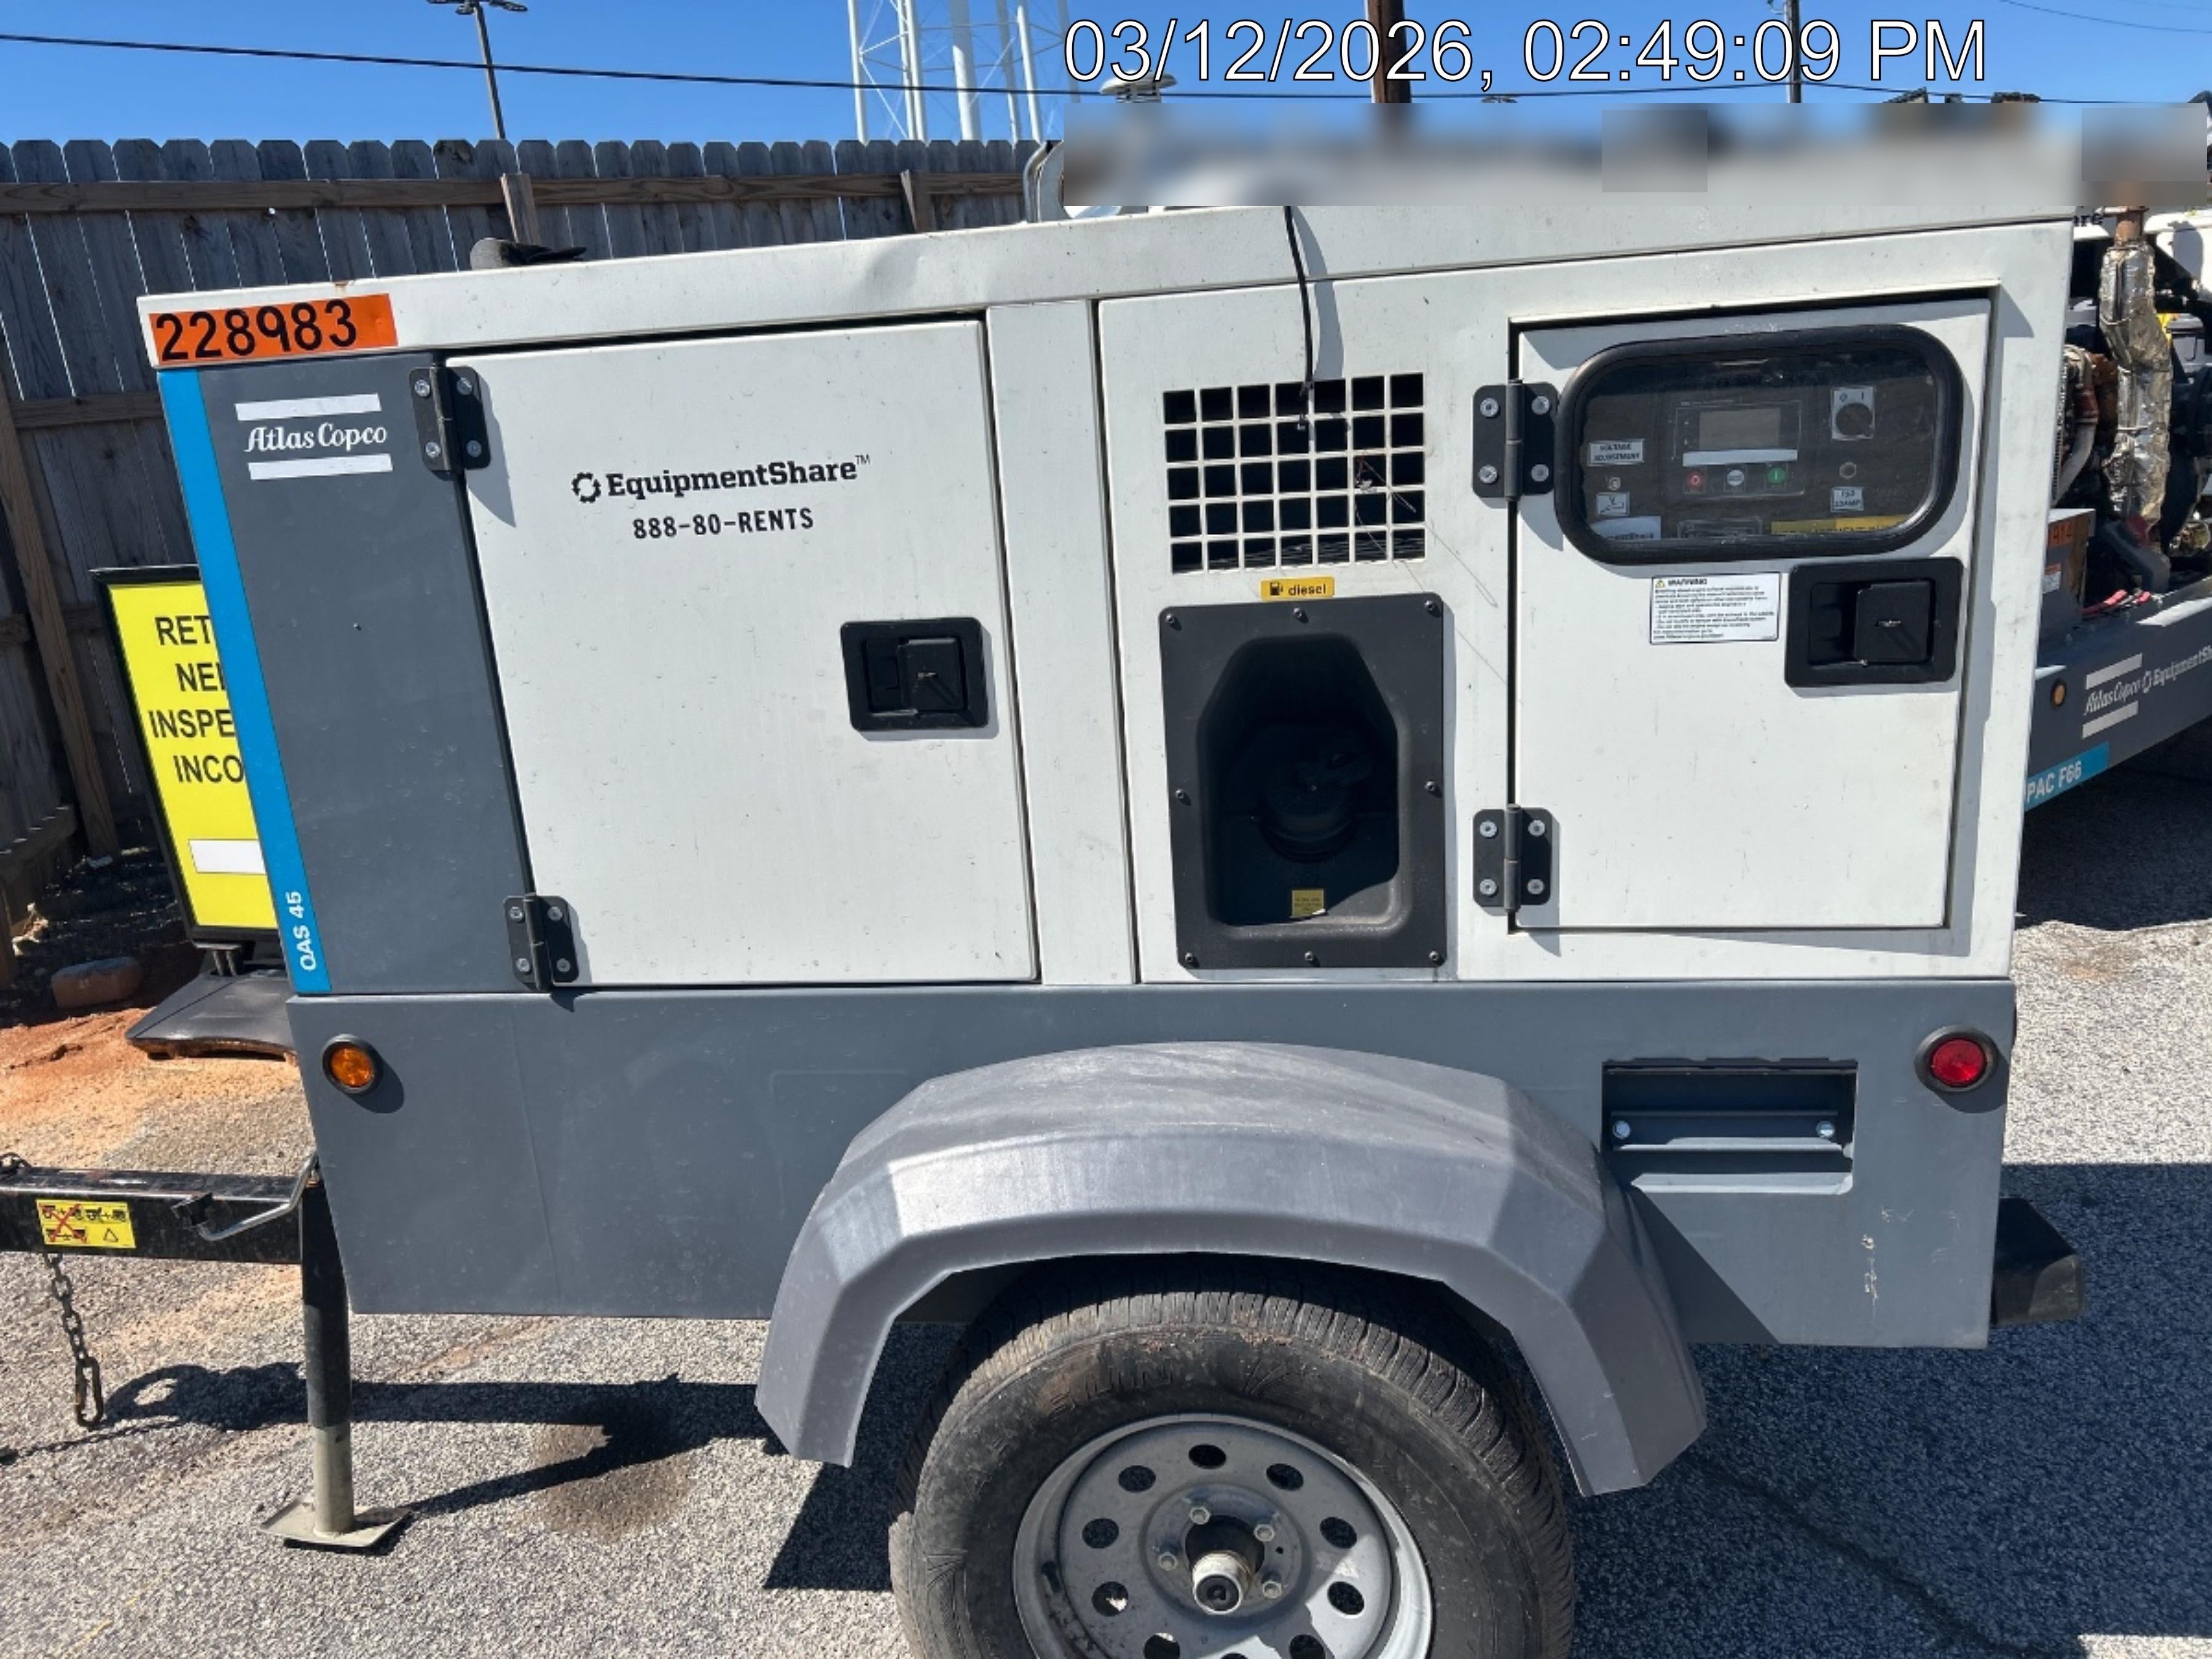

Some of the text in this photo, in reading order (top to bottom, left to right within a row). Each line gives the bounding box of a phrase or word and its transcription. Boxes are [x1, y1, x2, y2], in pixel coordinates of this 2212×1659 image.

[155, 299, 357, 362] 228983
[243, 422, 388, 453] Atlas Copco
[632, 508, 814, 539] 888-80-RENTS
[1288, 584, 1326, 596] diesel
[154, 615, 211, 646] RET
[148, 709, 237, 738] INSPE
[173, 755, 245, 783] INCO
[285, 891, 305, 919] 45
